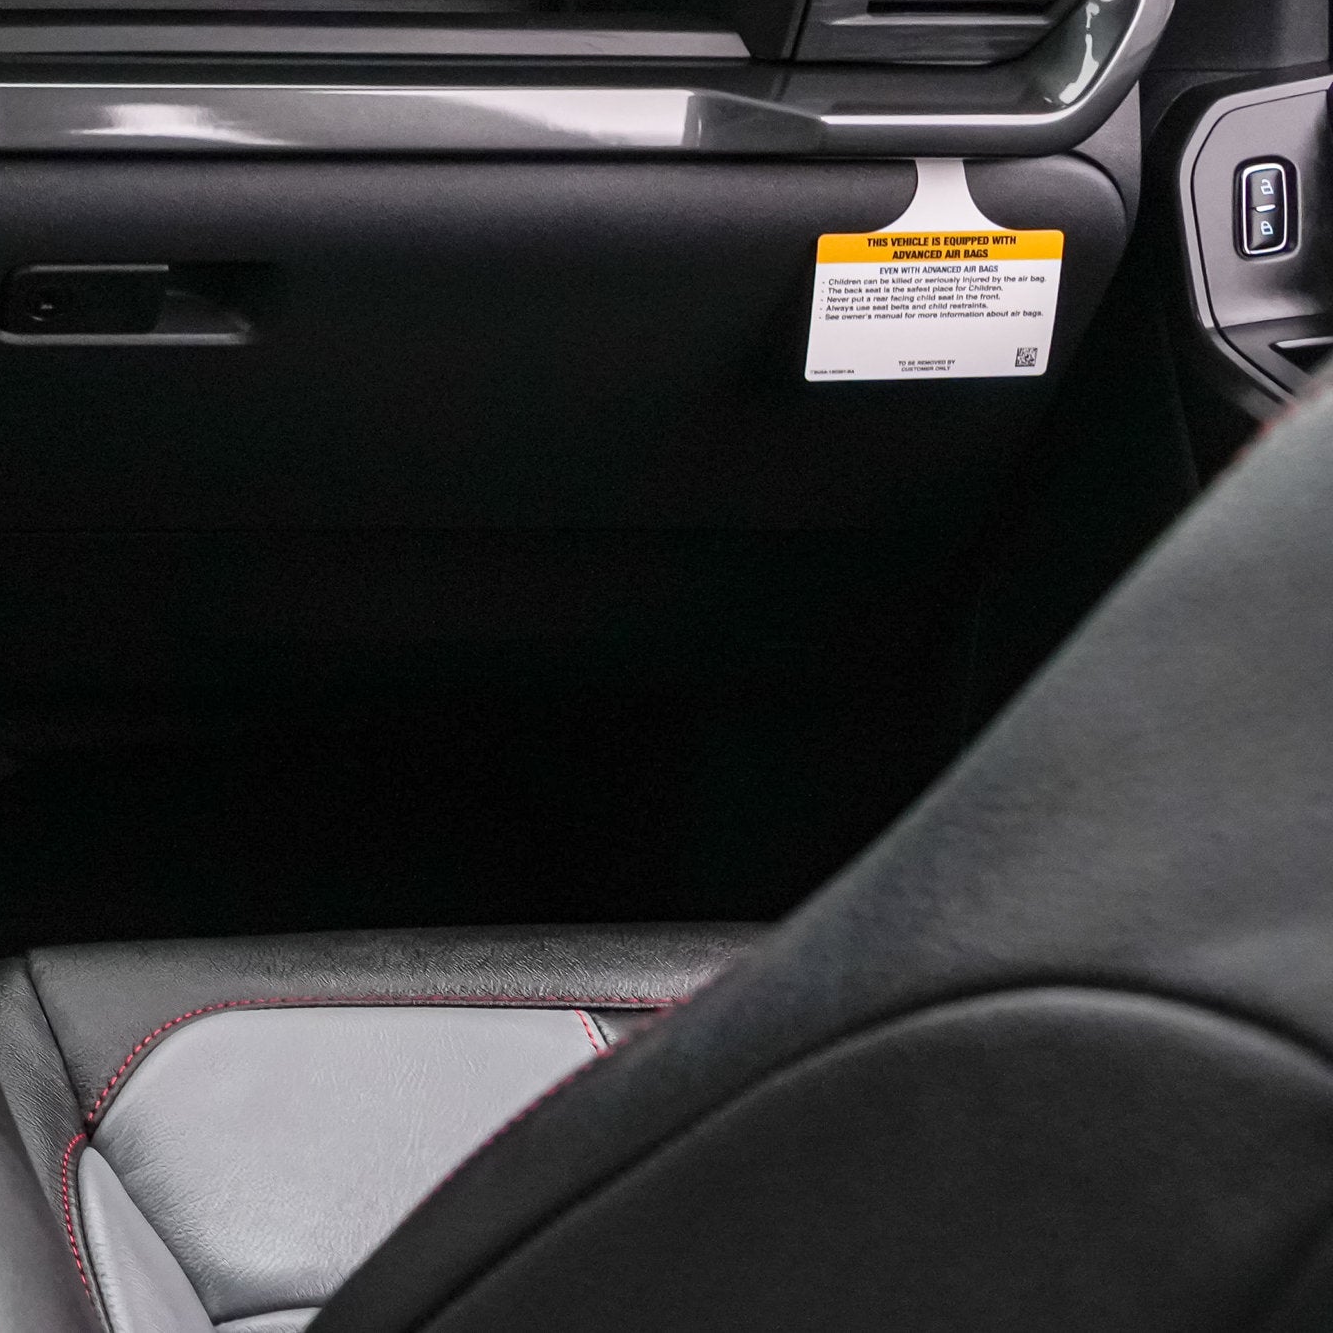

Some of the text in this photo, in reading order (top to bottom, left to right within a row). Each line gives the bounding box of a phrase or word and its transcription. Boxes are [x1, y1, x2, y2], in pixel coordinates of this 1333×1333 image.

[867, 236, 1016, 247] THIS VEHICLE IS EQUIPPED WITH
[892, 249, 988, 259] ADVANCED AIR BAGS
[901, 266, 920, 274] WITH
[932, 285, 953, 293] place
